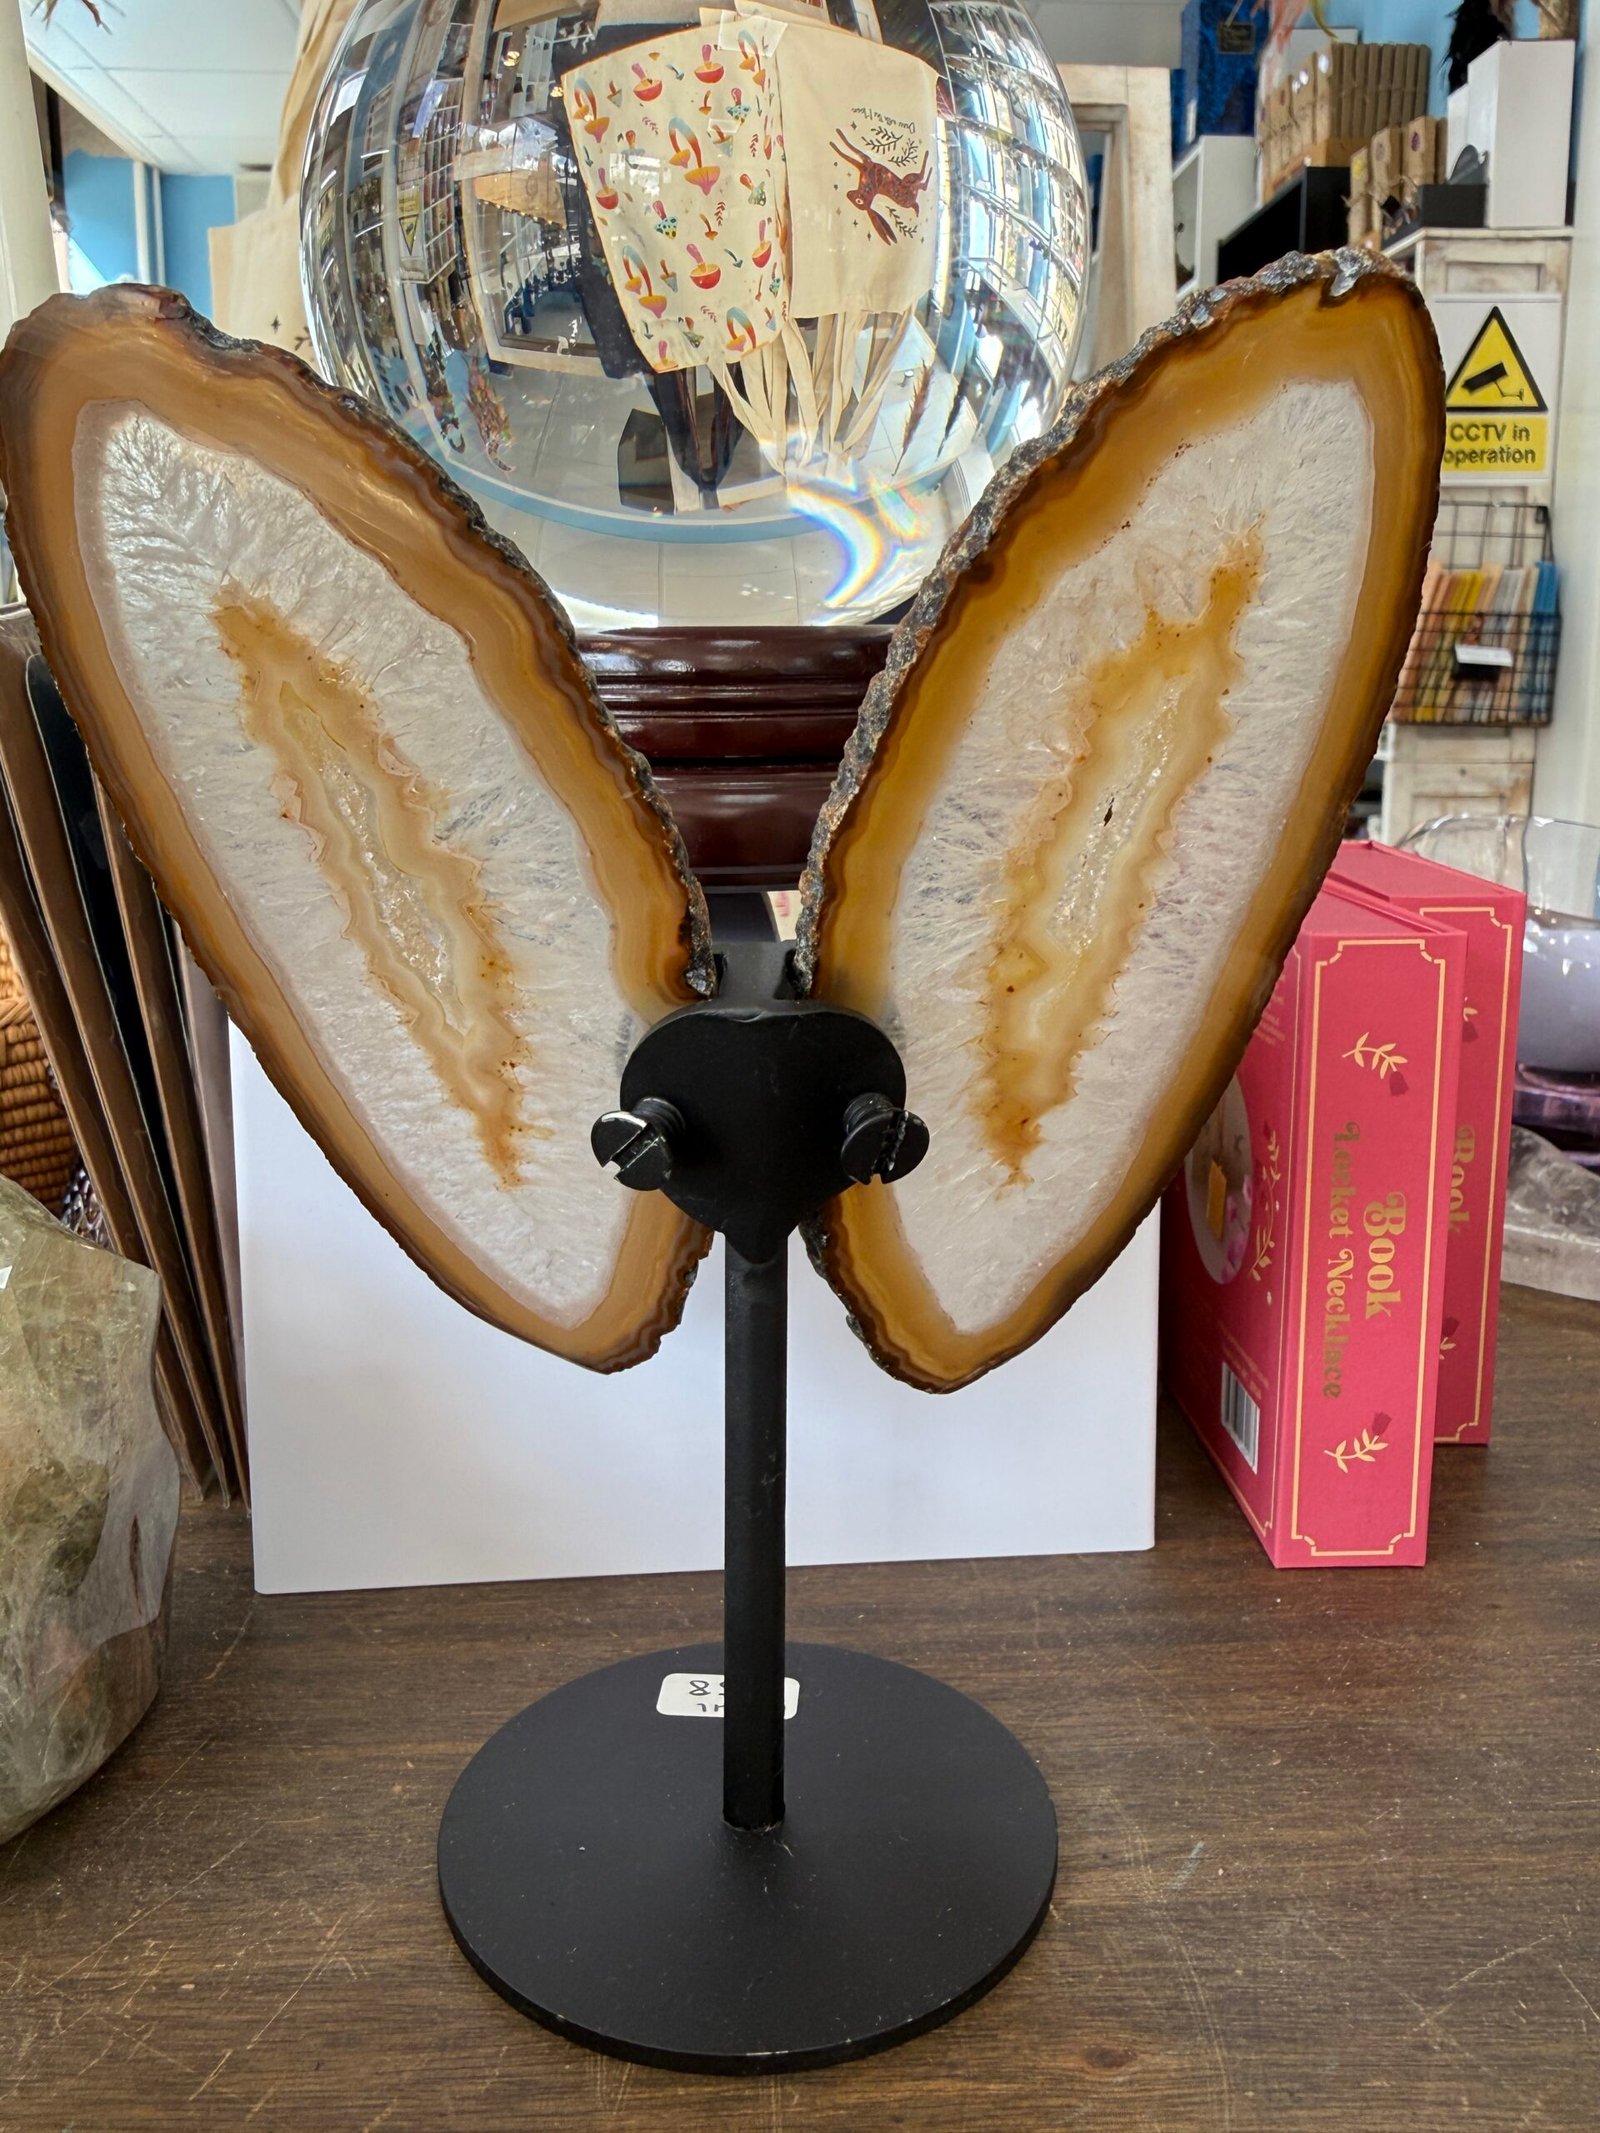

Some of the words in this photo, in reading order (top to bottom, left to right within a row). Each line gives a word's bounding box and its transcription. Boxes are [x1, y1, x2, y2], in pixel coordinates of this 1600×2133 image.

[1443, 445, 1537, 468] operation
[1450, 423, 1507, 442] CCTV
[1512, 424, 1531, 442] in
[1328, 1121, 1361, 1239] Locket
[1363, 1190, 1407, 1320] Book
[1322, 1248, 1354, 1399] Necklace
